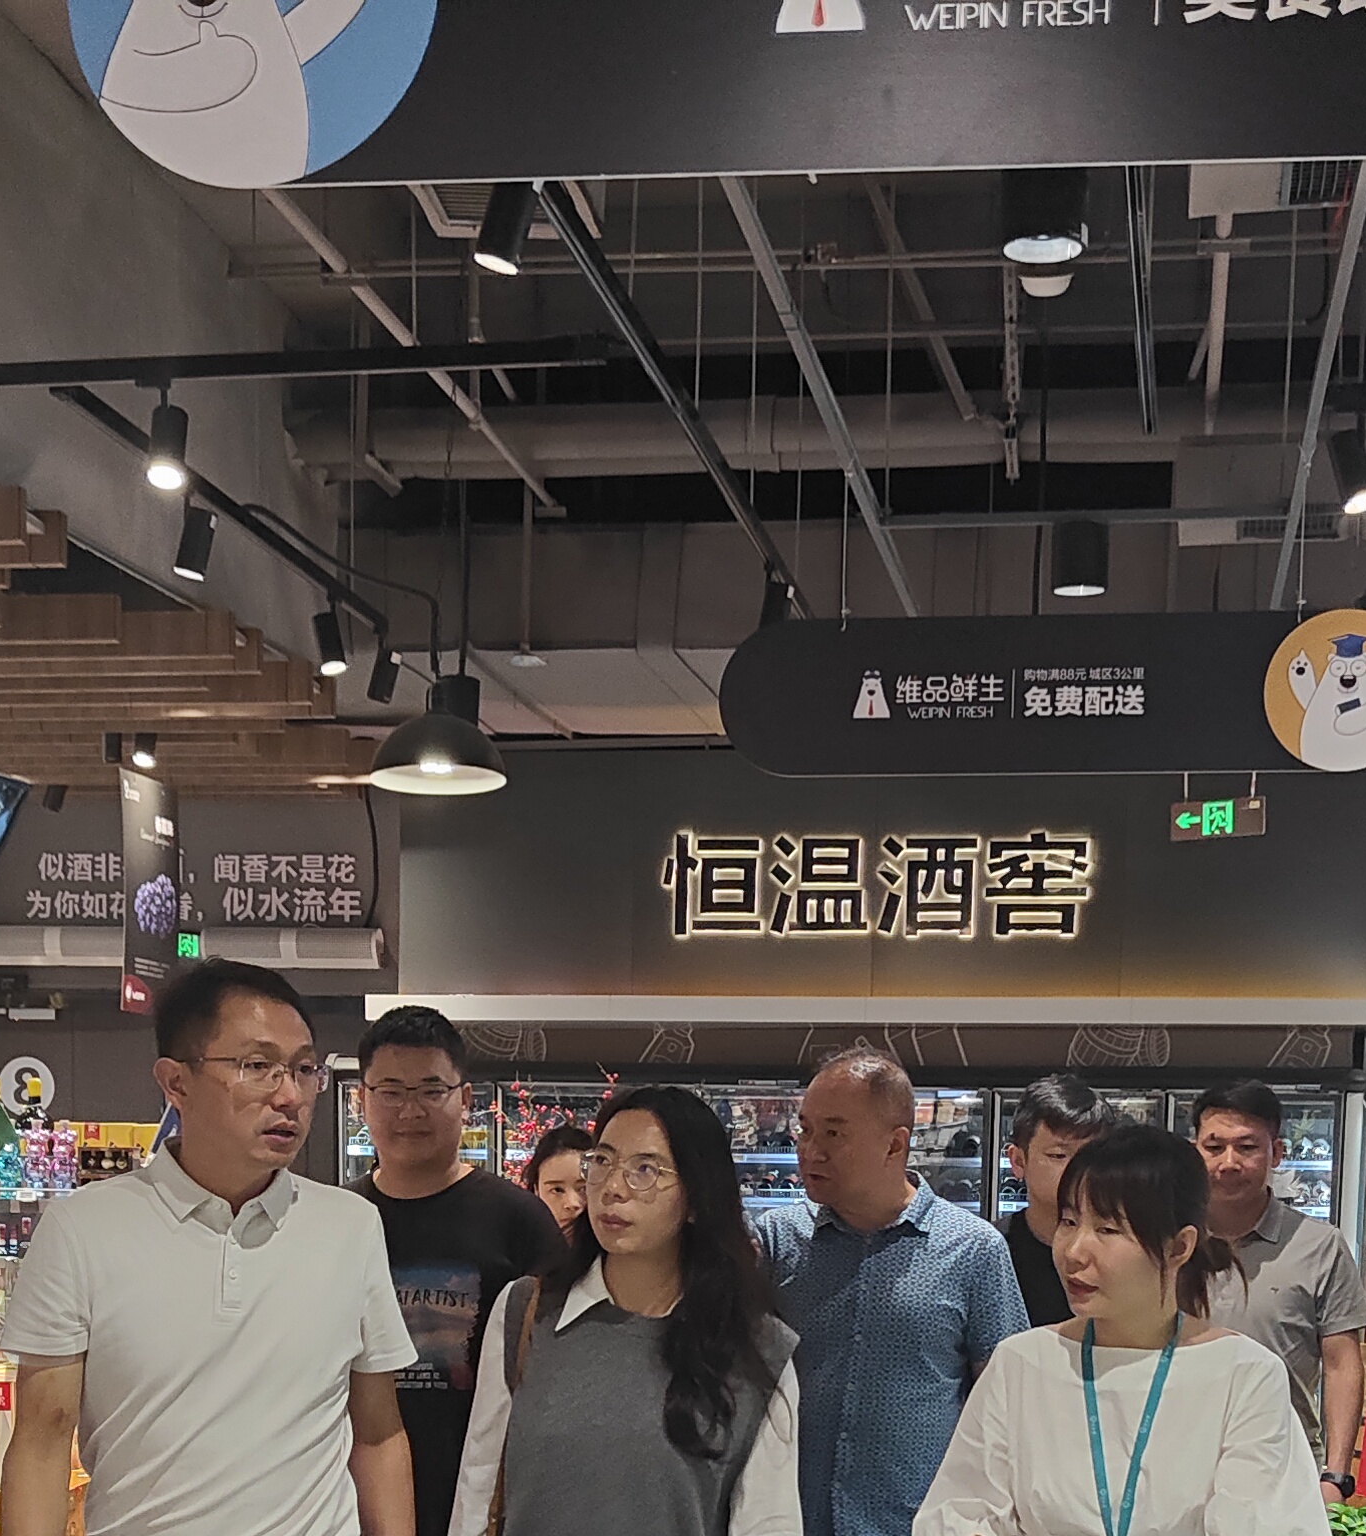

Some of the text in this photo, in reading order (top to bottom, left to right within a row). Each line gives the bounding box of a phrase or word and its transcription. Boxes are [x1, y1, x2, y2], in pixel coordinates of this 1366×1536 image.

[906, 0, 1110, 31] WEIPIN FRESH
[895, 673, 1005, 704] 维品鲜生
[1023, 685, 1145, 717] 免费配送
[907, 705, 994, 719] WEIPIN FRESH
[214, 854, 356, 885] 闻香不是花
[663, 831, 1093, 939] 恒温酒窖
[222, 886, 362, 923] 似水流年
[411, 1288, 469, 1308] ARTIST
